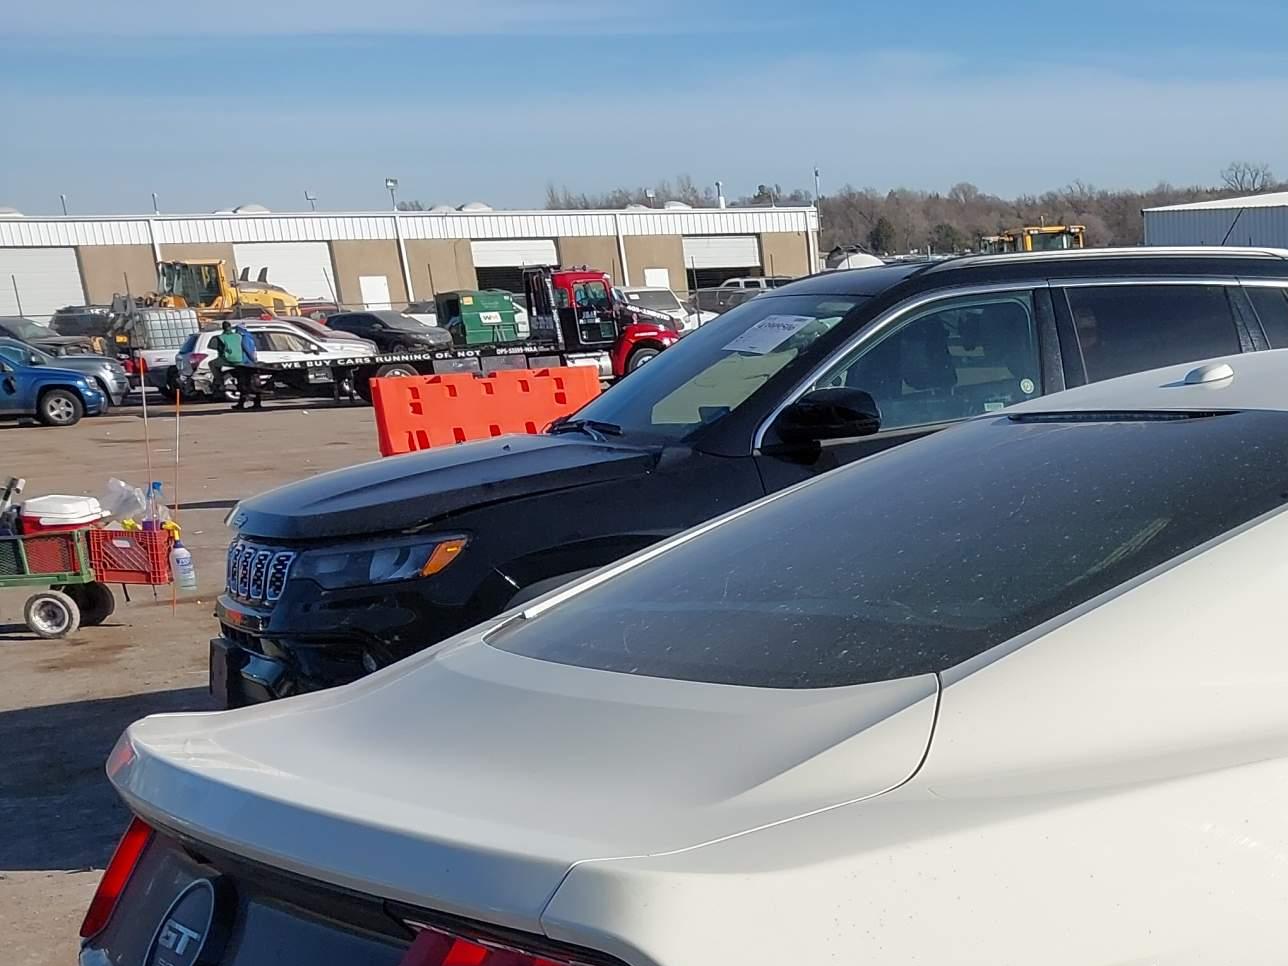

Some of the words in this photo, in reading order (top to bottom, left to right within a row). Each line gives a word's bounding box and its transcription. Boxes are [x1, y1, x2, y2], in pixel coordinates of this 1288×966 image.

[306, 359, 332, 367] BUY
[337, 357, 371, 365] CARS
[375, 353, 431, 363] RUNNING
[158, 918, 201, 956] GT
